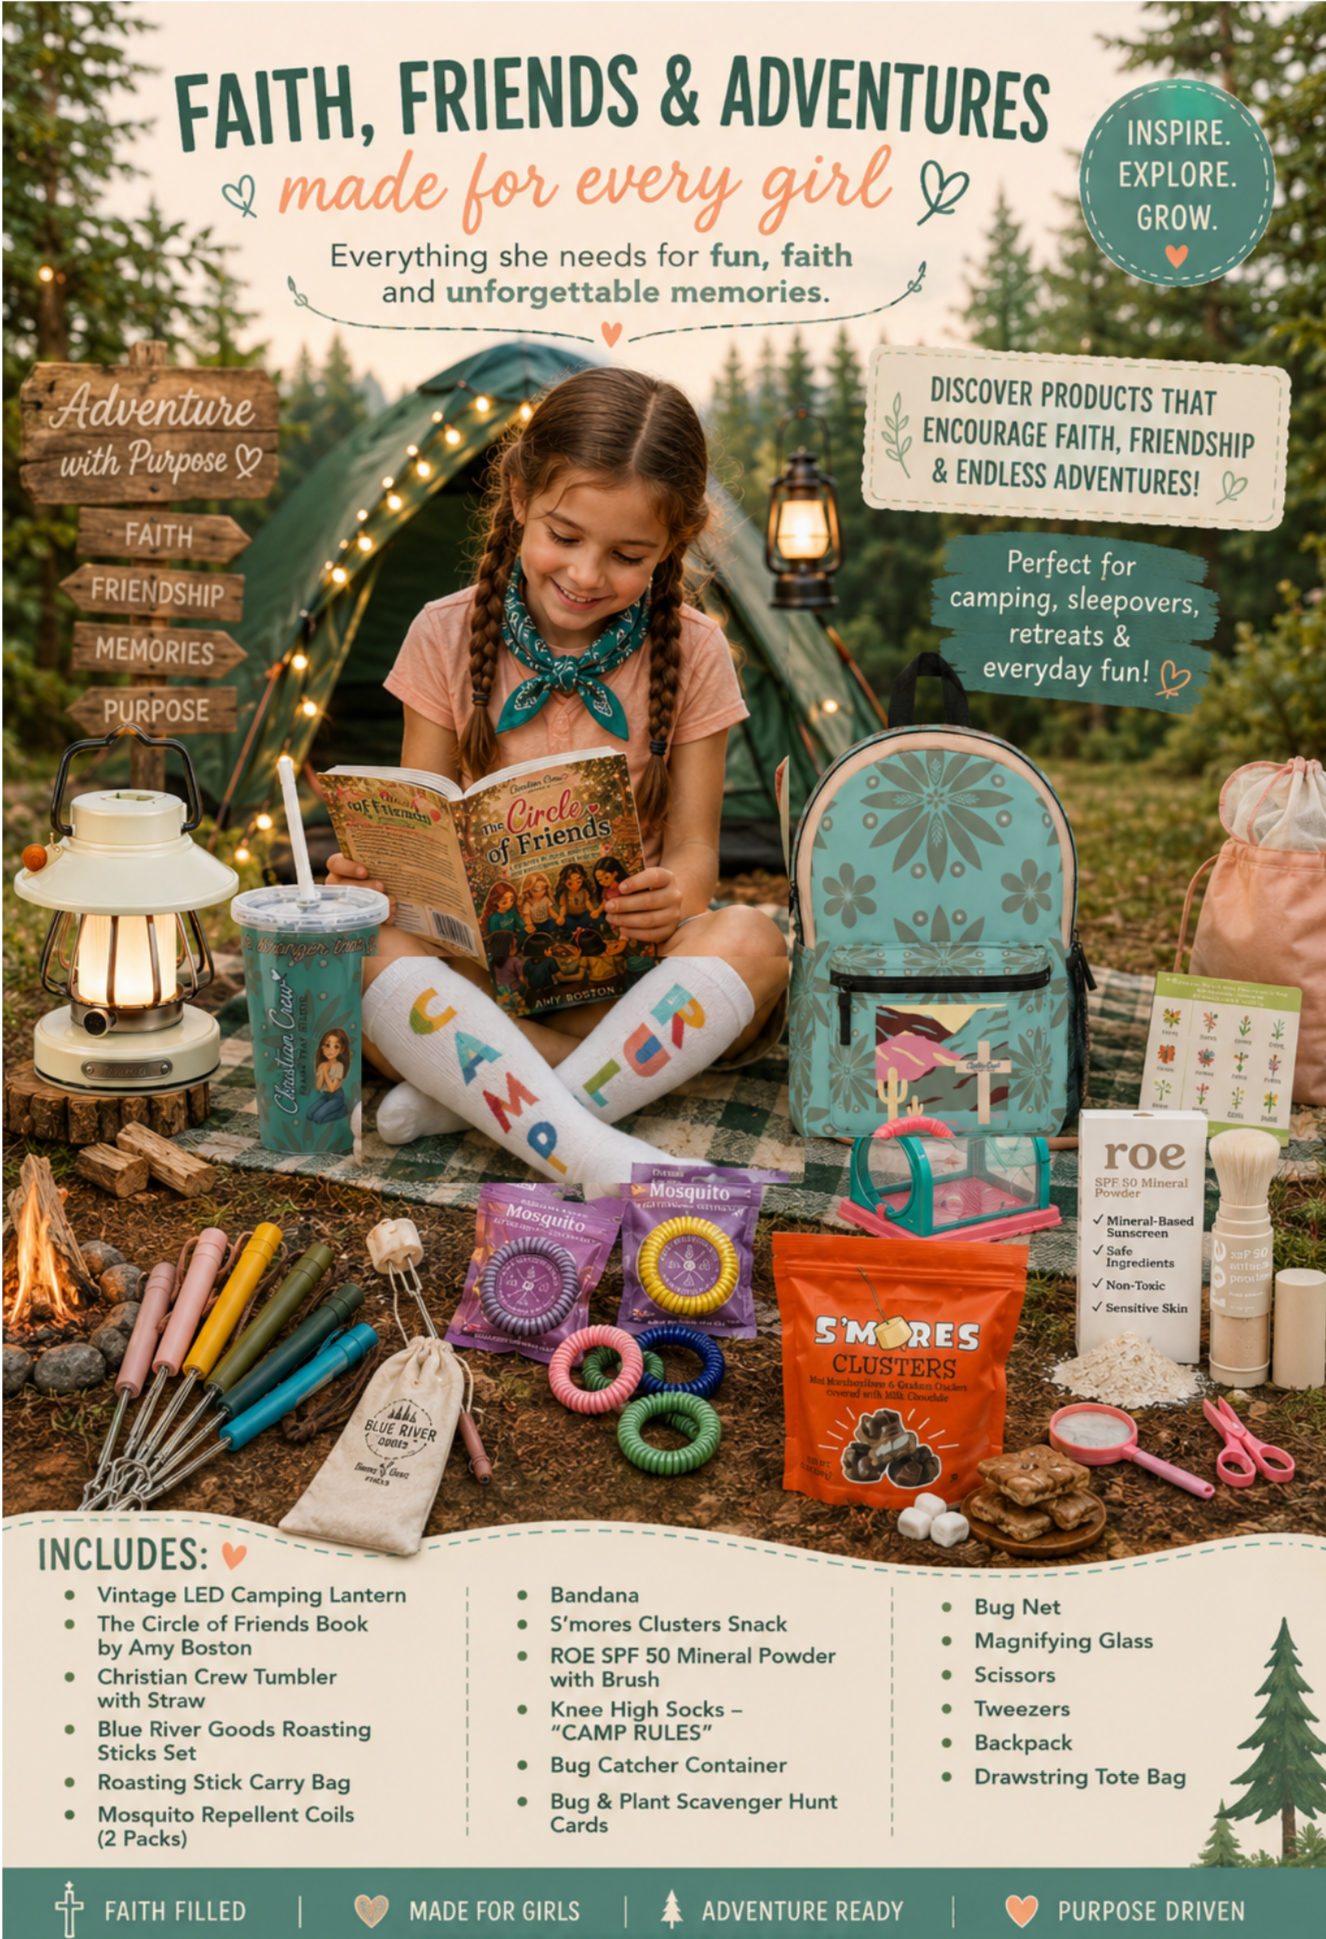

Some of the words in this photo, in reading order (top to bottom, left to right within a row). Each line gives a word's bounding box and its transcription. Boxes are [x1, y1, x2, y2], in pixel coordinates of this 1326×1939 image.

[49, 382, 255, 429] Adventure
[60, 445, 120, 477] with
[128, 439, 227, 484] Purpose
[126, 522, 193, 548] FAITH
[91, 577, 225, 608] FRIENDSHIP
[95, 636, 214, 665] MEMORIES
[104, 698, 209, 723] PURPOSE
[482, 822, 504, 836] The
[507, 789, 580, 834] Circle
[488, 837, 511, 865] of
[517, 817, 611, 856] Friends
[267, 979, 297, 1030] Crew
[1105, 1143, 1186, 1170] roe
[650, 1183, 730, 1204] Mosquito
[1094, 1188, 1141, 1198] Powder
[1095, 1178, 1118, 1188] SPF
[1141, 1178, 1188, 1188] Mineral
[505, 1204, 586, 1233] Mosquito
[1107, 1216, 1194, 1227] Mineral-Based
[1107, 1228, 1169, 1238] Sunscreen
[1106, 1258, 1175, 1269] Ingredients
[1107, 1246, 1133, 1256] Safe
[1106, 1280, 1166, 1291] Non-Toxic
[1106, 1303, 1159, 1314] Sensitive
[1162, 1303, 1188, 1314] Skin
[833, 1354, 956, 1379] CLUSTERS
[364, 1419, 394, 1435] BLUE
[399, 1423, 437, 1442] RIVER
